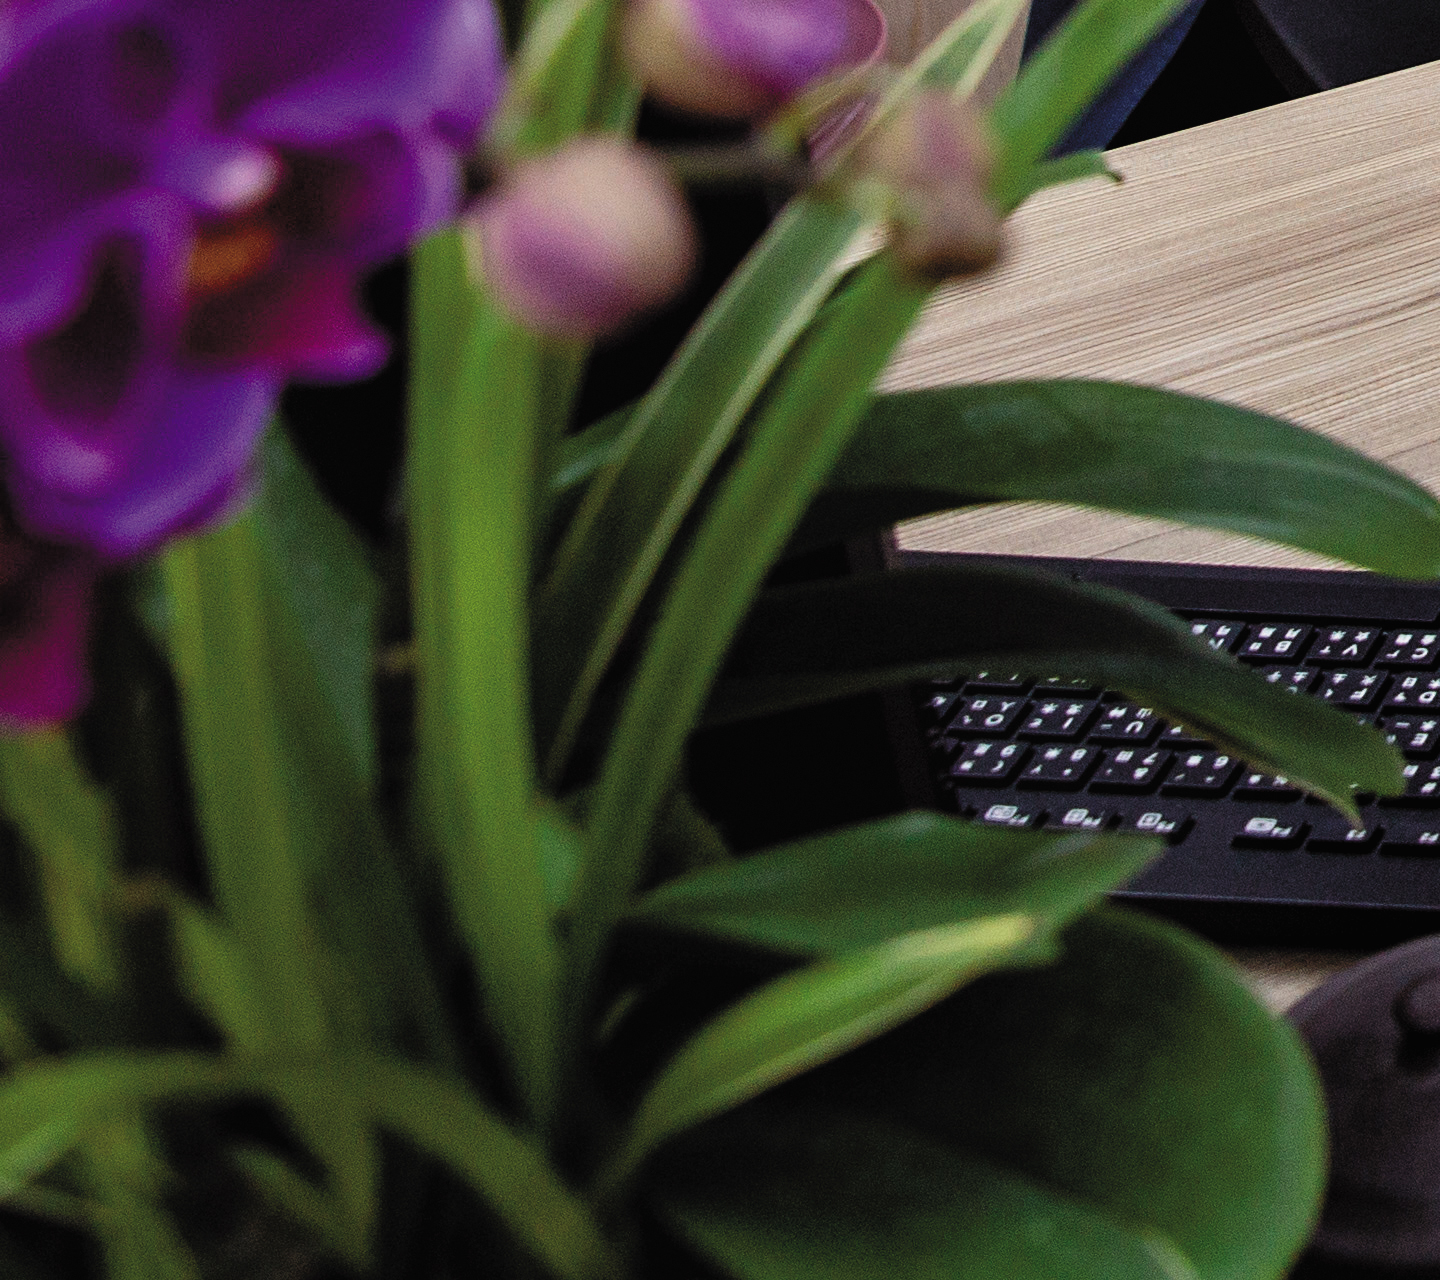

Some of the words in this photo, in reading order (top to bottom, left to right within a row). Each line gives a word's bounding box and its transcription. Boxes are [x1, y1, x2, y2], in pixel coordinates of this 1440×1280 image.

[1275, 640, 1292, 653] B
[1339, 643, 1359, 656] V
[1413, 648, 1428, 659] C
[1350, 688, 1368, 700] F
[1420, 691, 1437, 702] D
[986, 714, 1004, 727] O
[1124, 720, 1144, 734] U
[1411, 732, 1428, 746] E
[1002, 745, 1016, 758] 9
[1074, 748, 1087, 762] 8
[1144, 752, 1159, 765] 7
[1214, 755, 1230, 768] 6
[1420, 832, 1439, 842] F2
